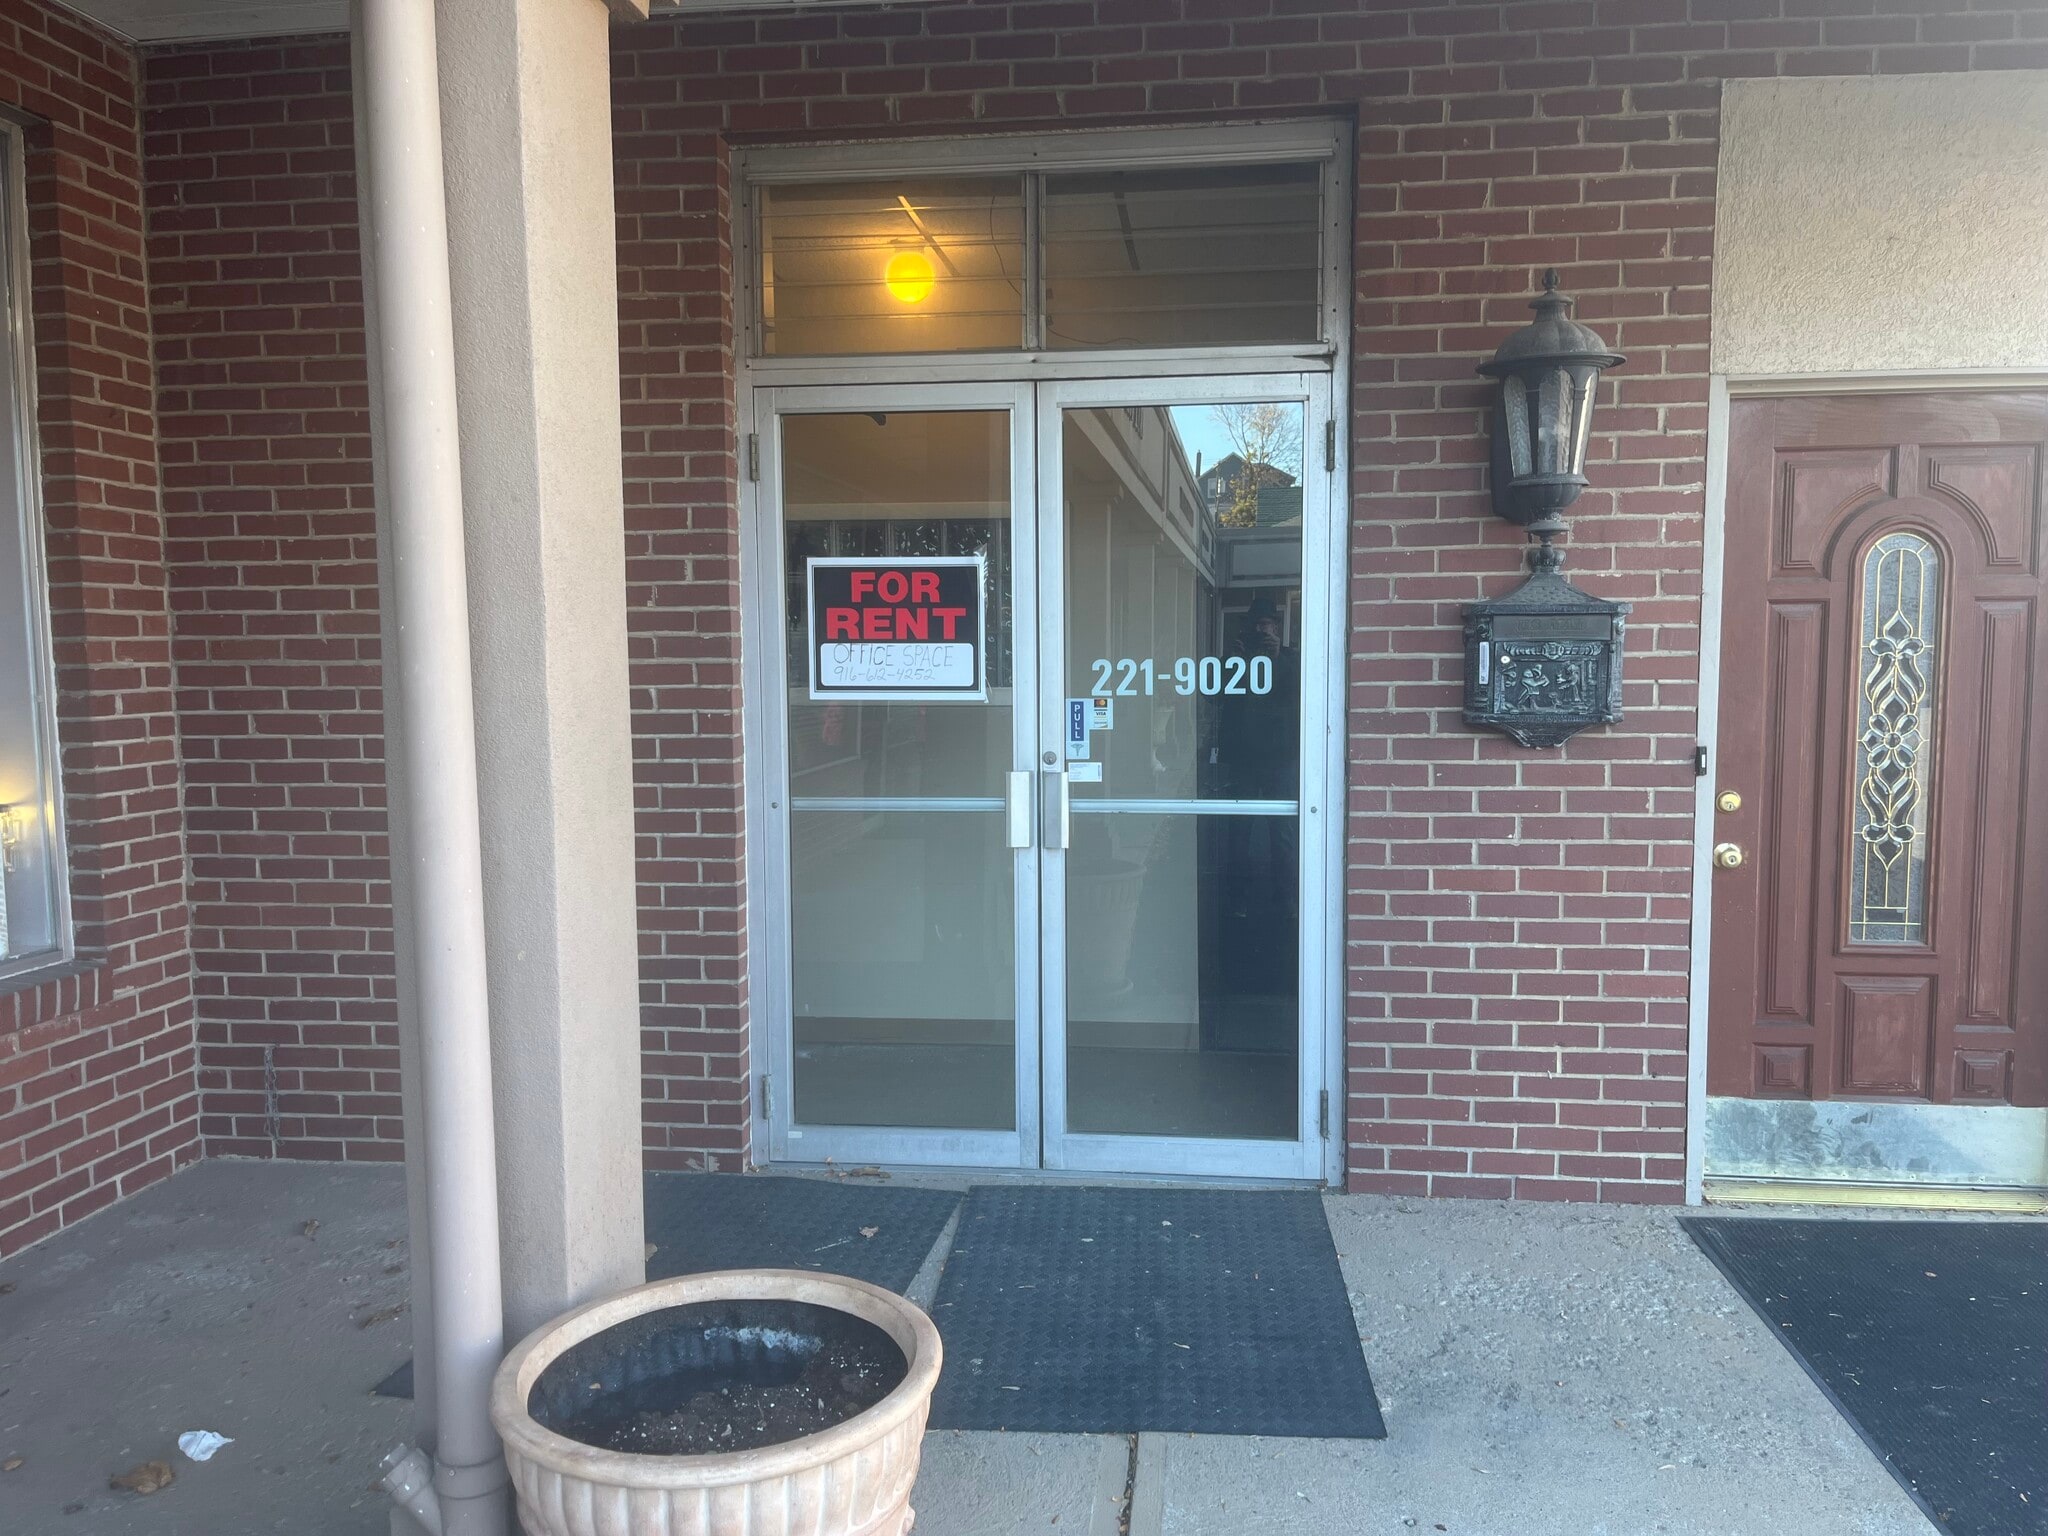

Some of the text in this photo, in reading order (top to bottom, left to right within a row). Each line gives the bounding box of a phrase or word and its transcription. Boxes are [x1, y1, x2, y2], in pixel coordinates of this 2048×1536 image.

[851, 571, 940, 603] FOR
[826, 607, 966, 640] RENT
[833, 642, 954, 668] OFFICE SPACE
[1091, 655, 1273, 696] 221-9020
